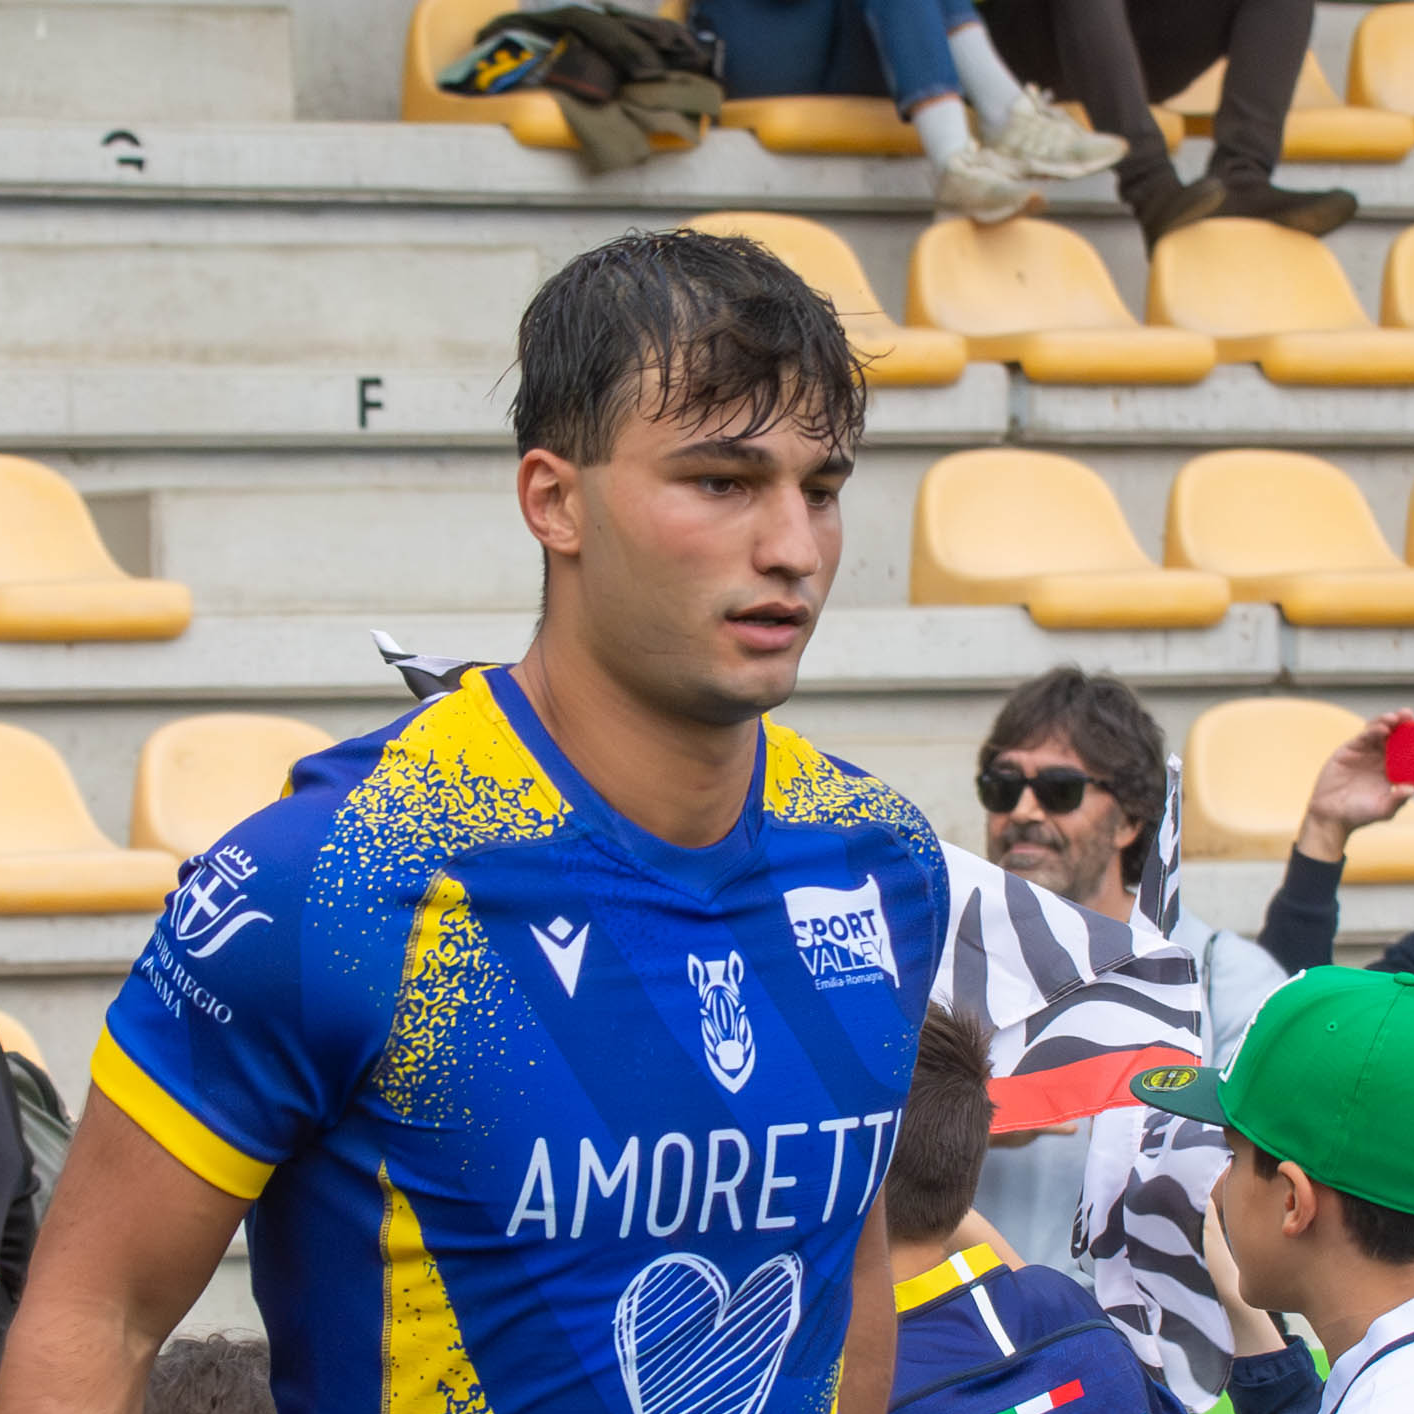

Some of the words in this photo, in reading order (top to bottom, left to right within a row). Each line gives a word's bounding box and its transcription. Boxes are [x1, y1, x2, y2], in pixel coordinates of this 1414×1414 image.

[357, 377, 384, 429] F
[792, 909, 878, 949] SPORT
[799, 938, 884, 976] VALLEY
[172, 963, 233, 1024] REGIO
